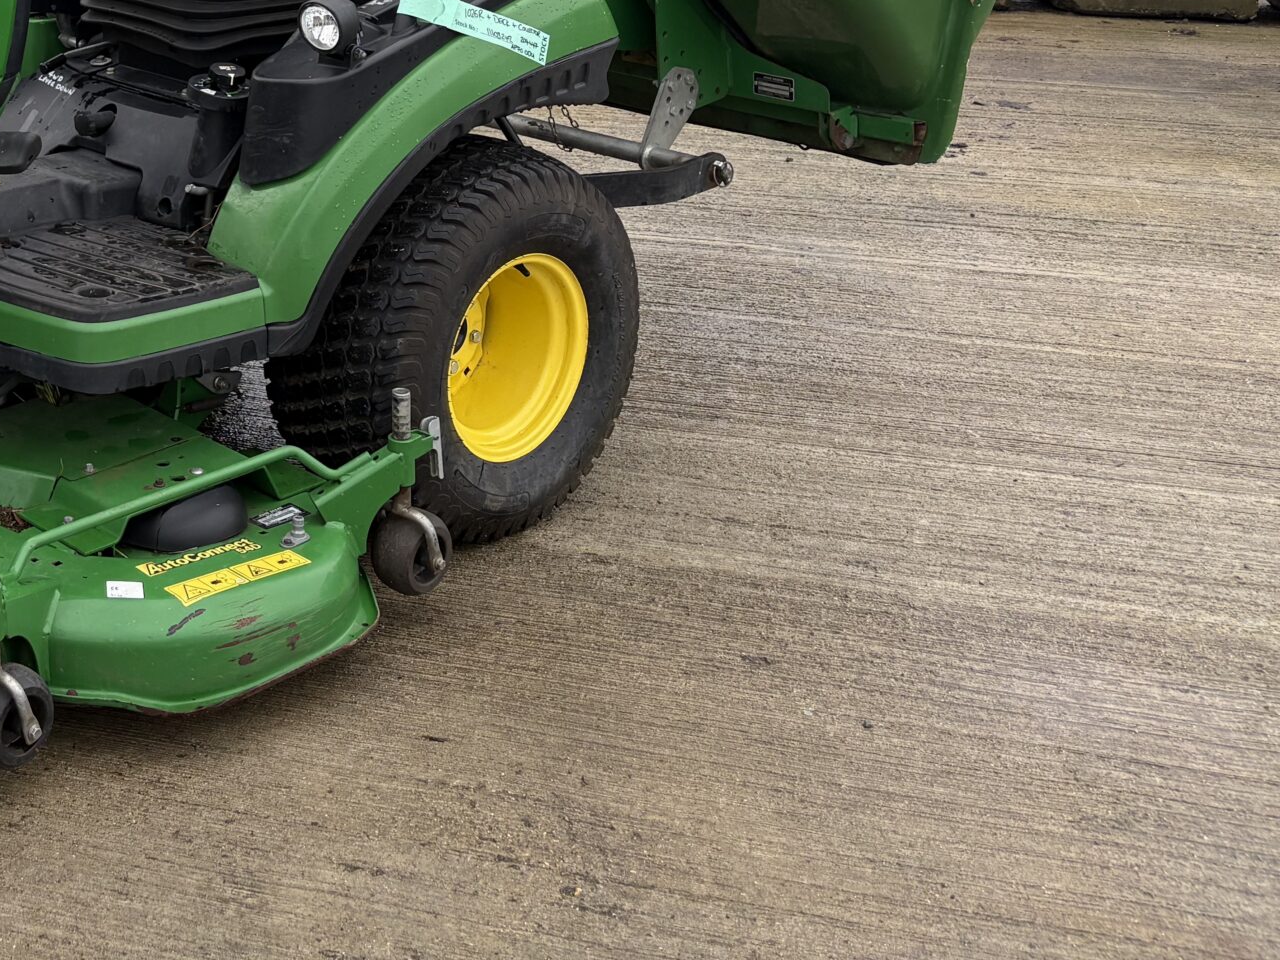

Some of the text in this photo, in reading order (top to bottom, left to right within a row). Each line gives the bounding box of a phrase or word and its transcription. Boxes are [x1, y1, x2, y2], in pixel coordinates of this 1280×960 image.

[539, 36, 548, 62] STOCK
[147, 538, 255, 576] AutoConnect
[234, 542, 262, 555] 54D
